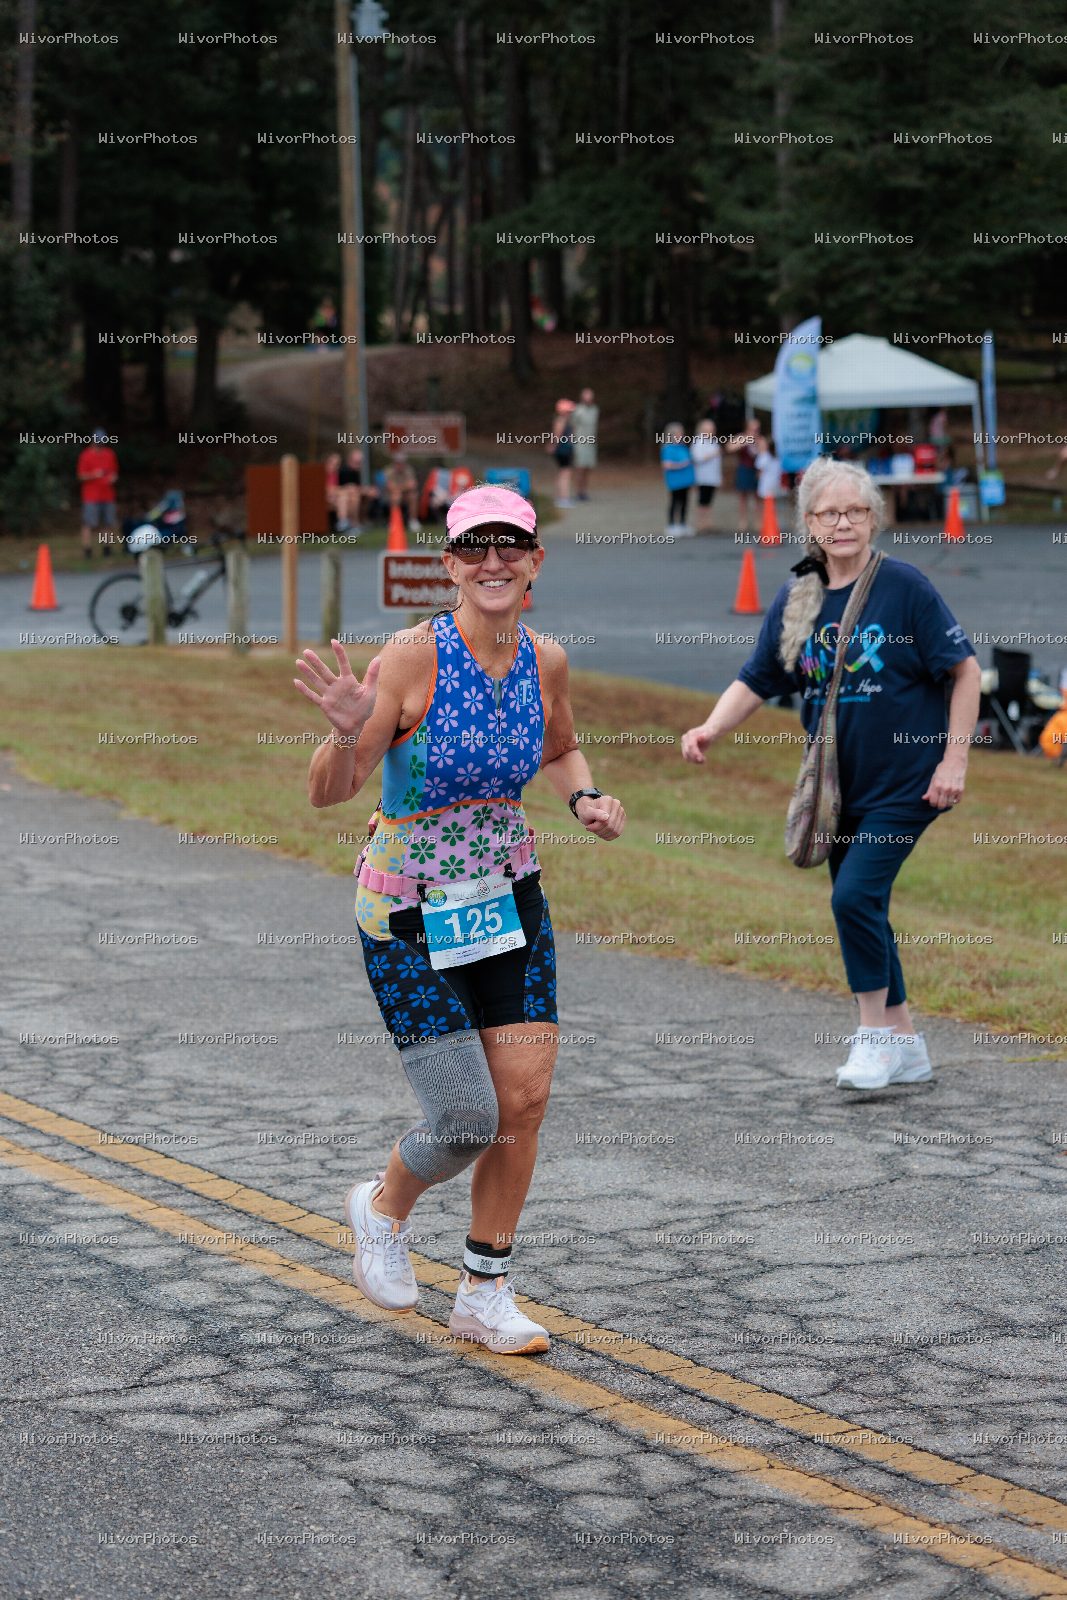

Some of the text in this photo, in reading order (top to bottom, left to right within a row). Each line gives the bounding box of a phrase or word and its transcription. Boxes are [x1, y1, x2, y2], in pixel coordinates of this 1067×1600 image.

[388, 560, 452, 579] Intoxic
[391, 584, 456, 603] Prohib
[445, 902, 502, 942] 125
